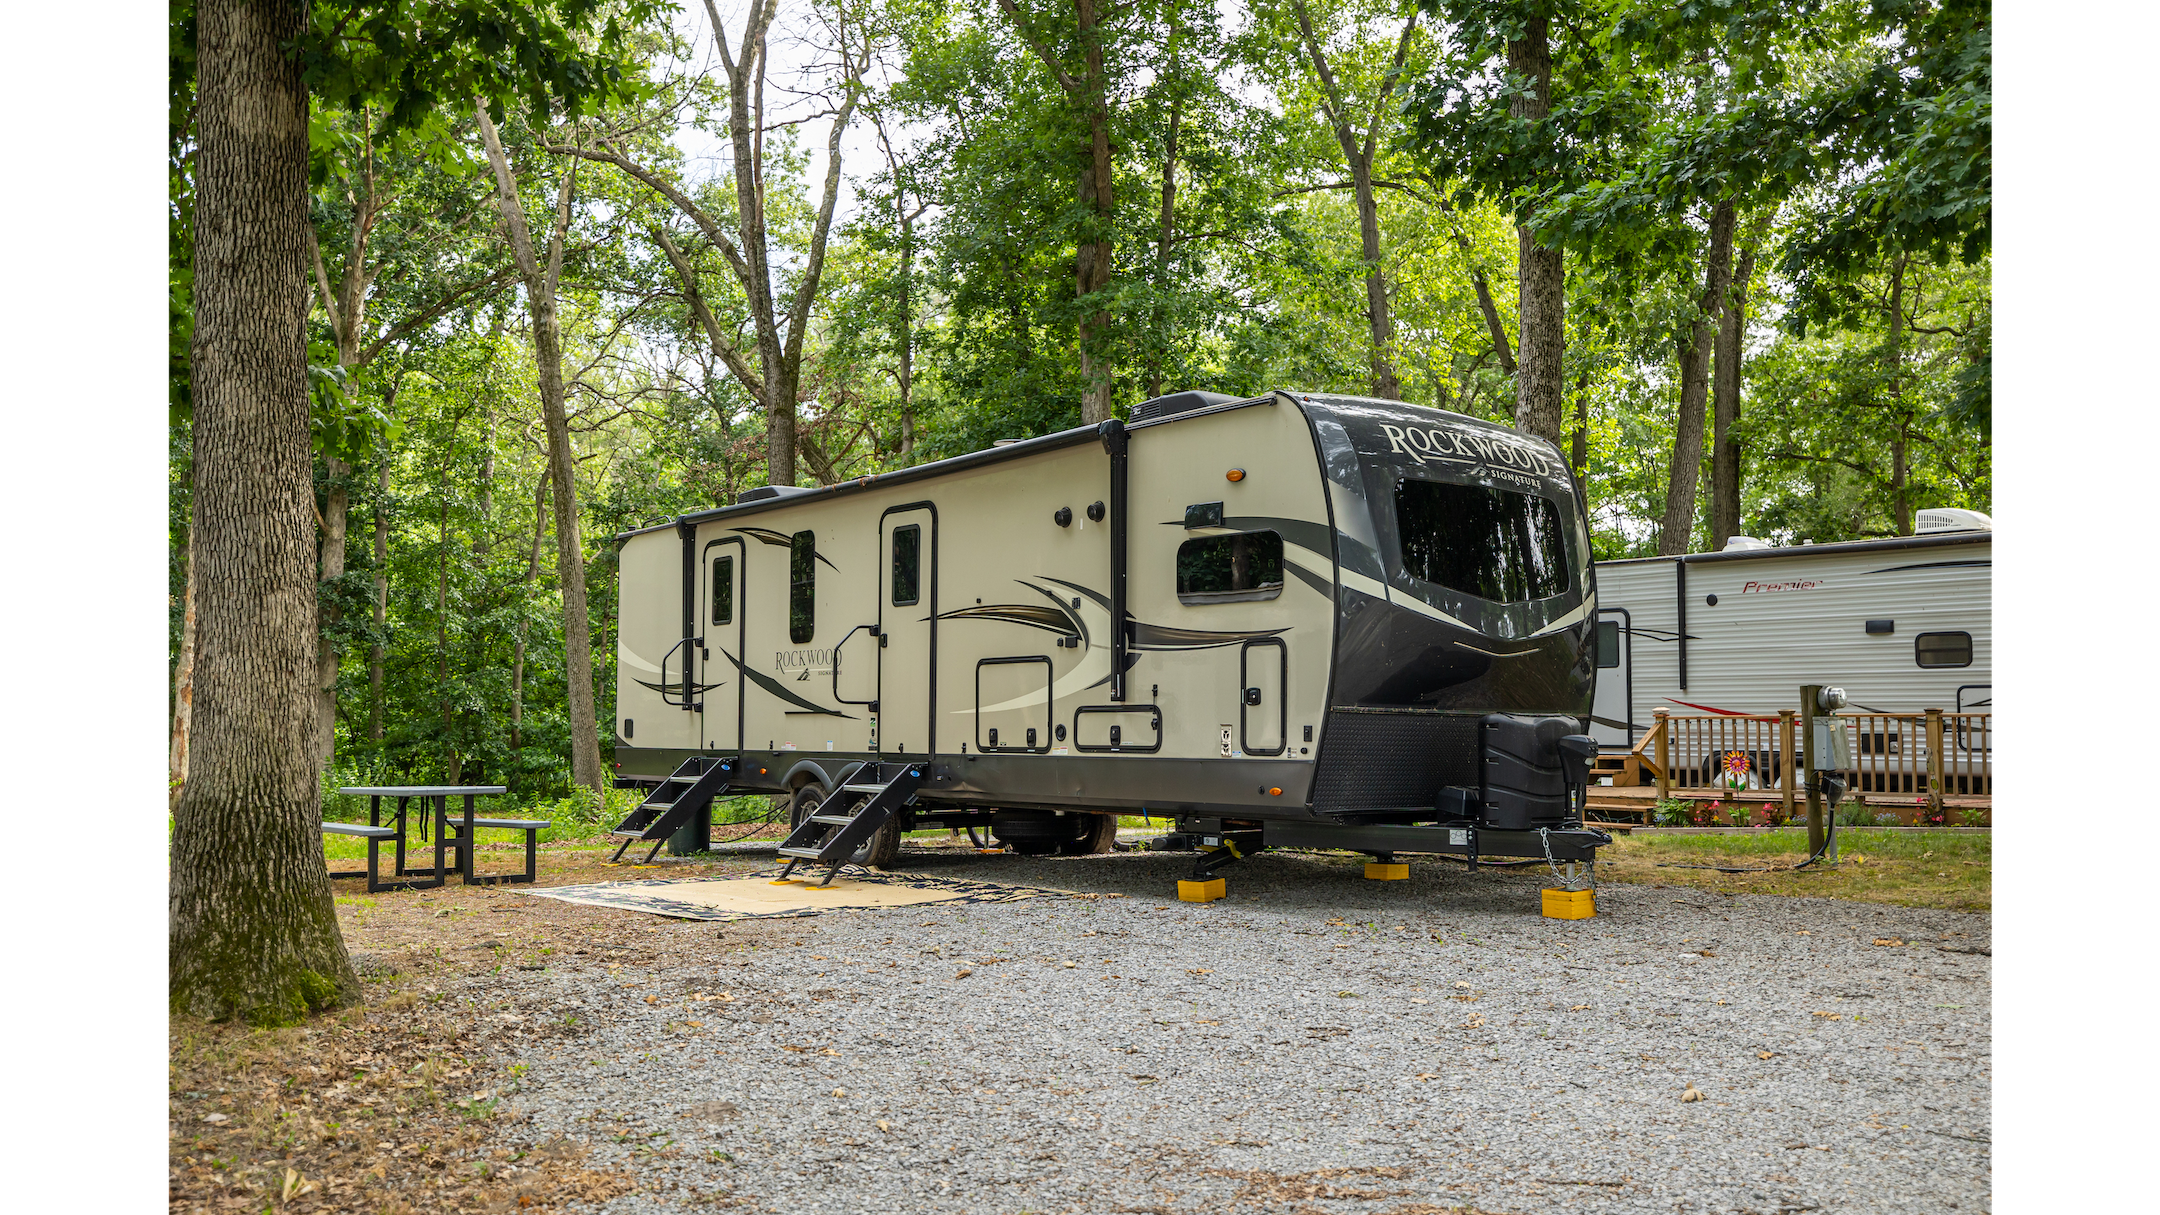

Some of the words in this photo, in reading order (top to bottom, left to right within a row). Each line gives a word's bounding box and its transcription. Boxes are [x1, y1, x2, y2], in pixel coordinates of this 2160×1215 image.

[1379, 424, 1549, 476] ROCKWOOD
[1491, 470, 1541, 489] SIGNATURE
[1743, 579, 1823, 593] Premier
